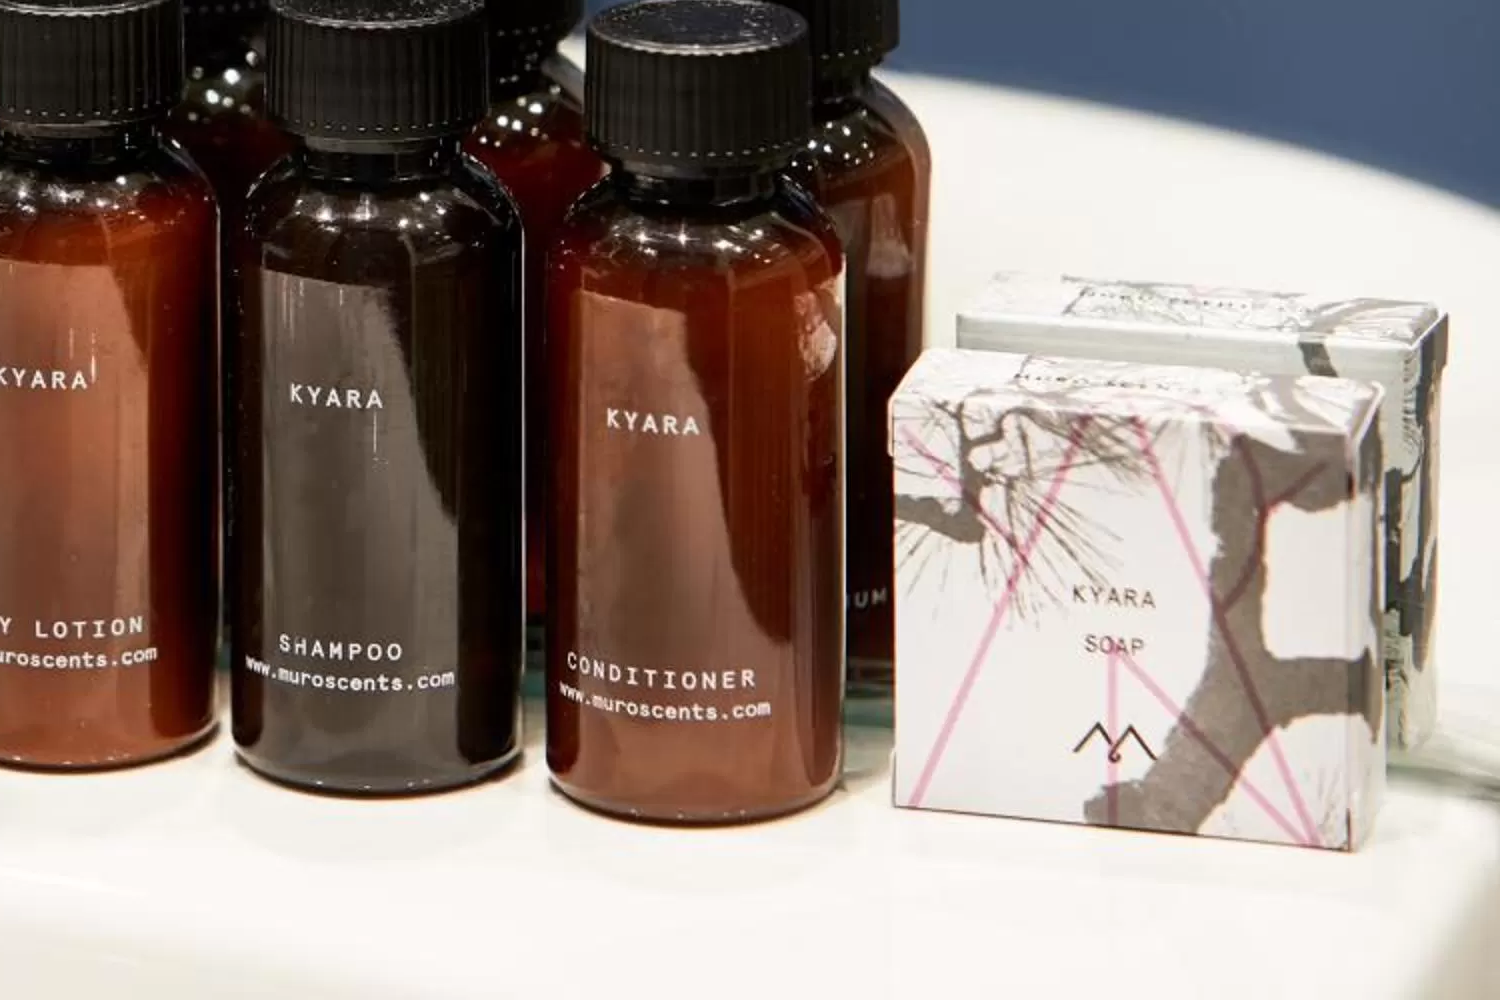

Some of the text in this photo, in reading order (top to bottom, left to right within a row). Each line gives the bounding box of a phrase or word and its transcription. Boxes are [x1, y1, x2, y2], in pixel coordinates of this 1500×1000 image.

[290, 383, 383, 409] KYARA
[606, 407, 700, 436] KYARA
[1072, 584, 1156, 609] KYARA
[35, 615, 143, 639] LOTION
[279, 633, 403, 662] SHAMPOO
[1084, 633, 1145, 656] SOAP
[245, 655, 455, 692] www.muroscents.com
[567, 651, 757, 690] CONDITIONER
[559, 681, 772, 720] www.muroscents.com
